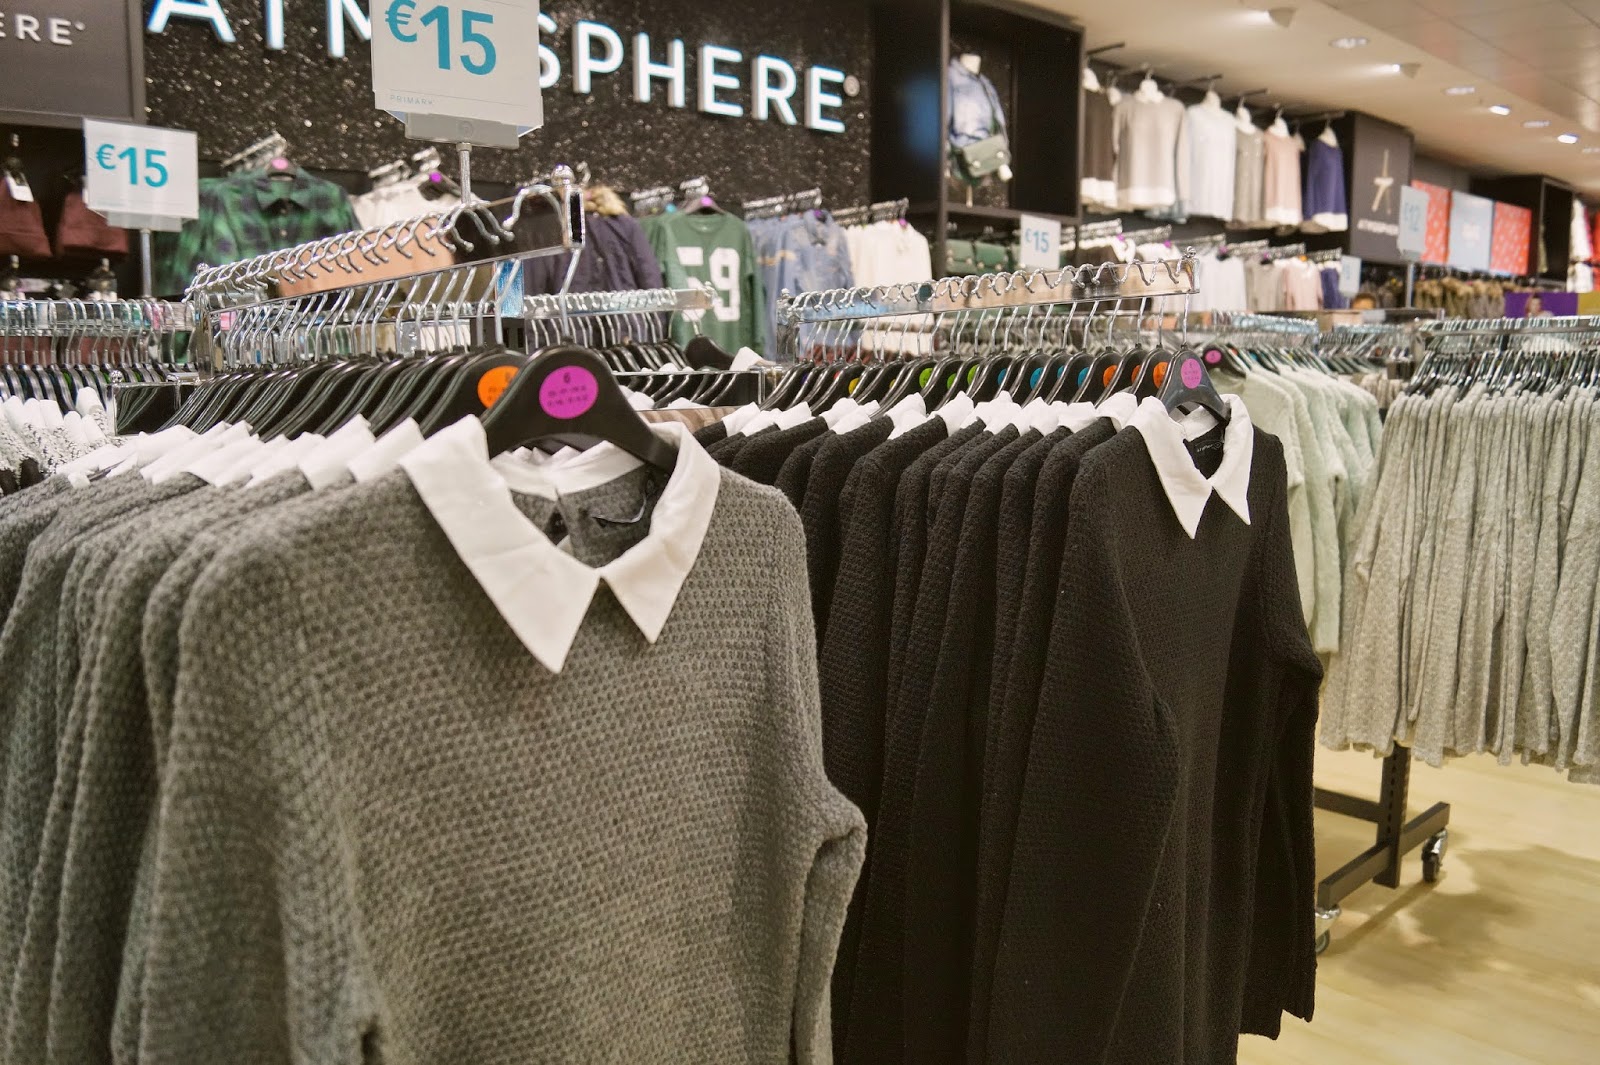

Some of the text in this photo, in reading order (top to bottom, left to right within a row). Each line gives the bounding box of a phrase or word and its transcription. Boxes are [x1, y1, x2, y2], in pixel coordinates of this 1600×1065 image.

[0, 12, 73, 46] RE
[385, 0, 497, 76] €15
[96, 143, 169, 188] €15
[1025, 228, 1050, 253] €15
